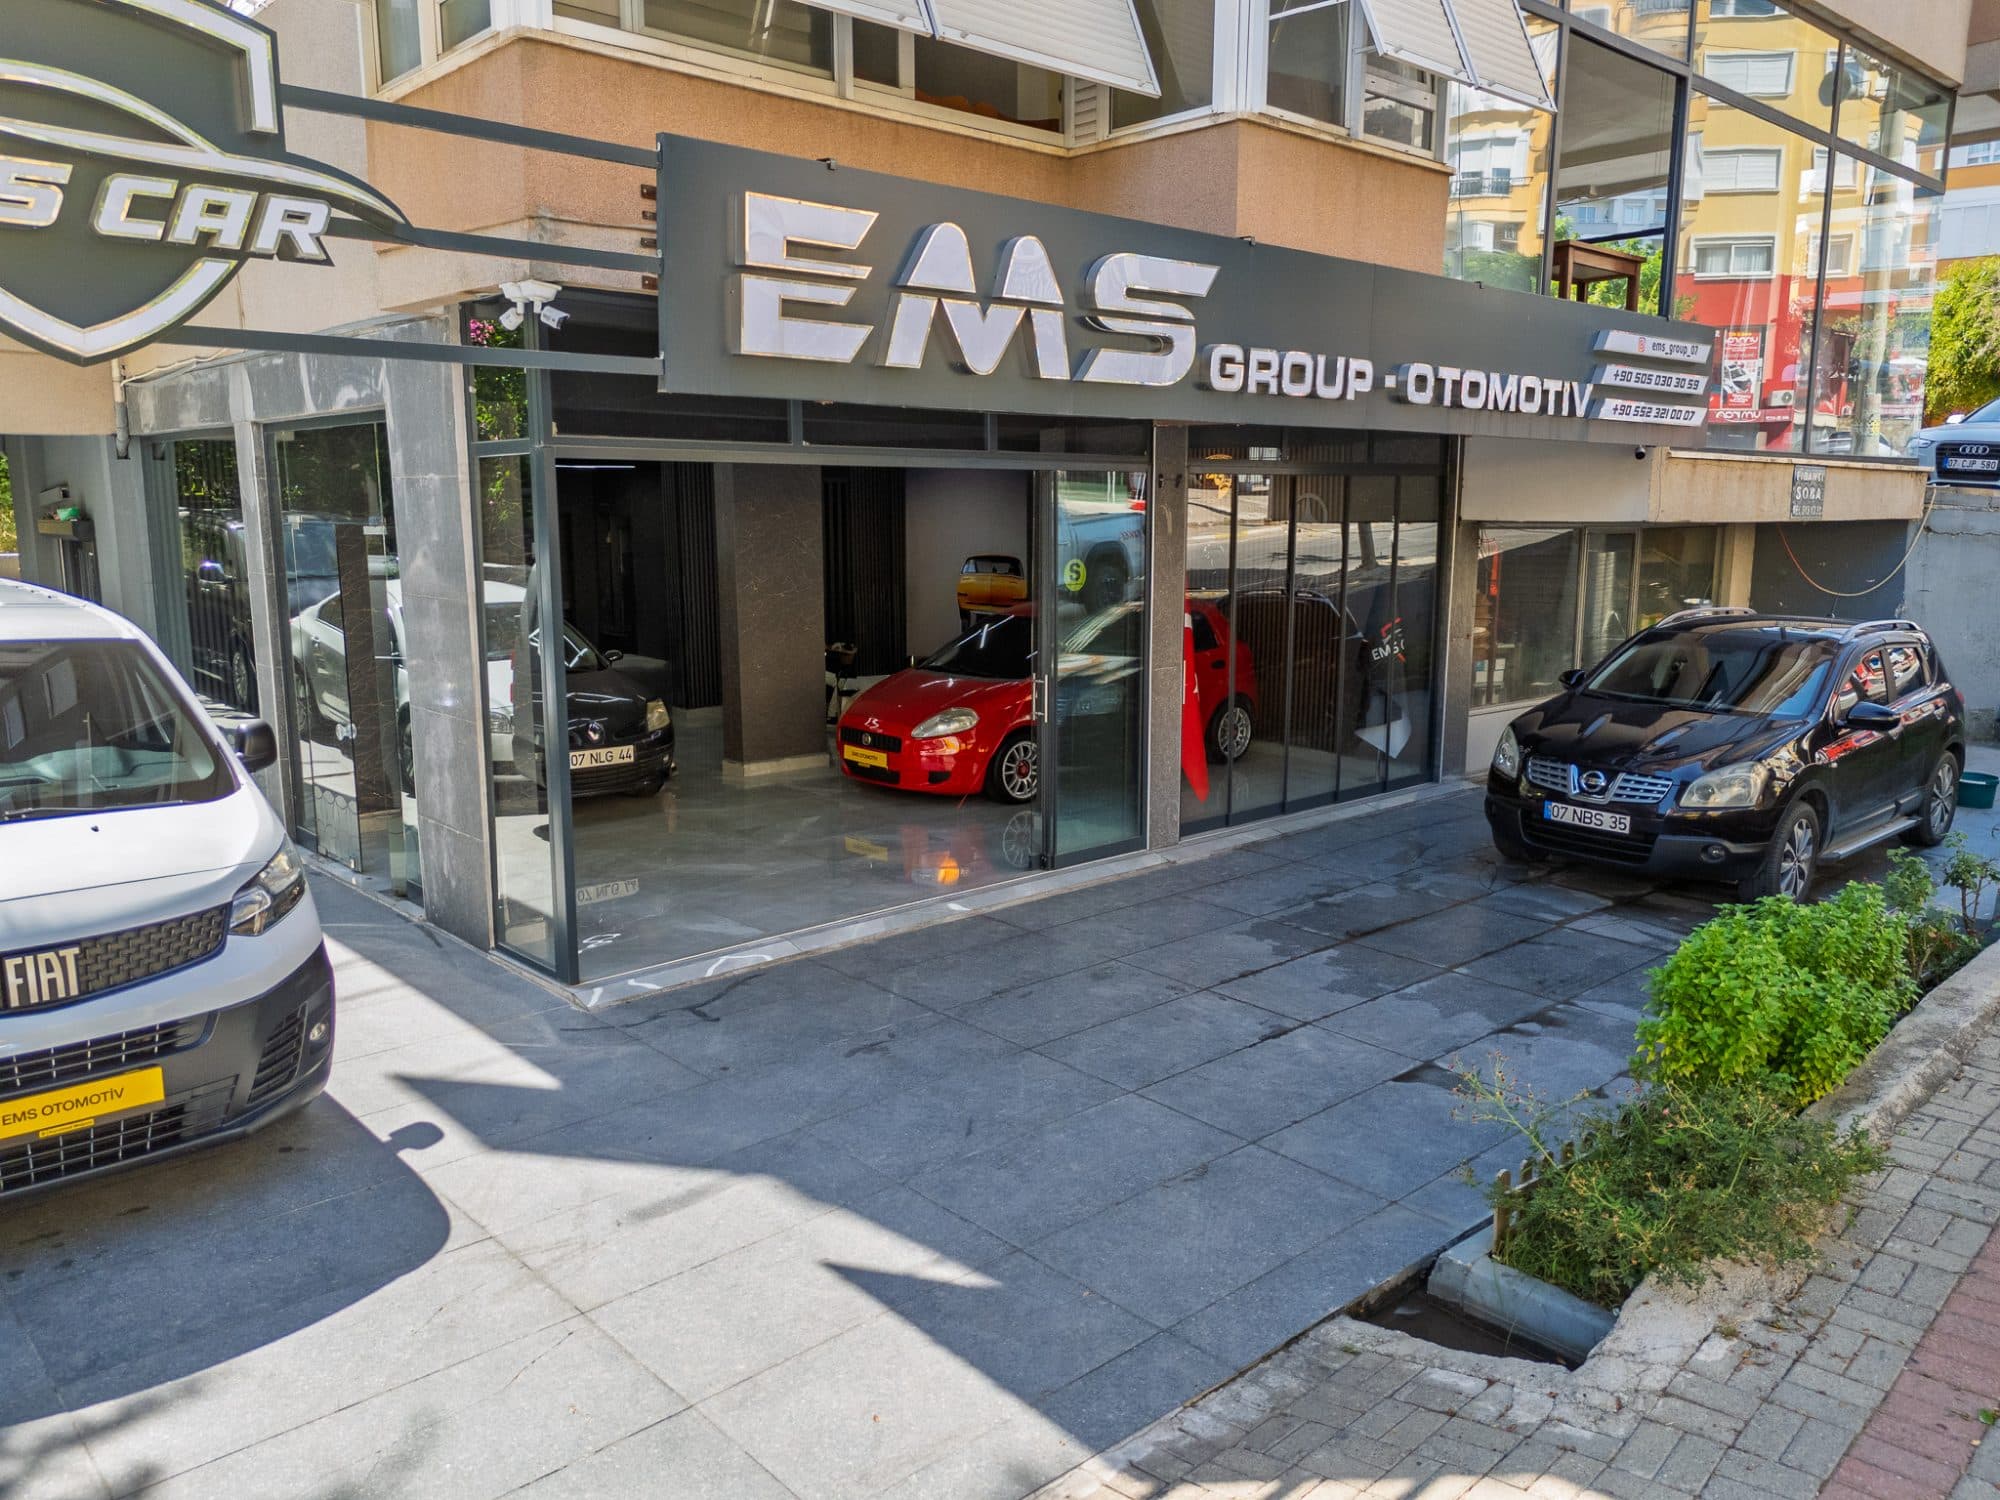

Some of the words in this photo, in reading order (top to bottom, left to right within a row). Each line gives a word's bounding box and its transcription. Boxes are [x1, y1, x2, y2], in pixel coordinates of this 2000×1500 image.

[93, 172, 332, 262] CAR
[735, 190, 1221, 387] EMS
[1208, 343, 1374, 401] GROUP
[1405, 361, 1594, 419] OTOMOTIV
[1614, 369, 1633, 382] +90
[1634, 372, 1654, 385] 505
[1654, 375, 1673, 388] 030
[1674, 378, 1686, 389] 30
[1686, 379, 1700, 391] 59
[1612, 403, 1632, 416] +90
[1633, 405, 1652, 418] 552
[1653, 407, 1669, 420] 321
[1670, 408, 1682, 421] 00
[1682, 409, 1696, 421] 07
[570, 754, 586, 766] 07
[589, 751, 614, 764] NLG
[618, 747, 632, 760] 44
[1552, 804, 1568, 820] 07
[1571, 808, 1604, 827] NBS
[1609, 815, 1627, 831] 35
[4, 947, 80, 1008] FIAT
[2, 1108, 38, 1126] EMS
[41, 1087, 125, 1117] OTOMOTİV
